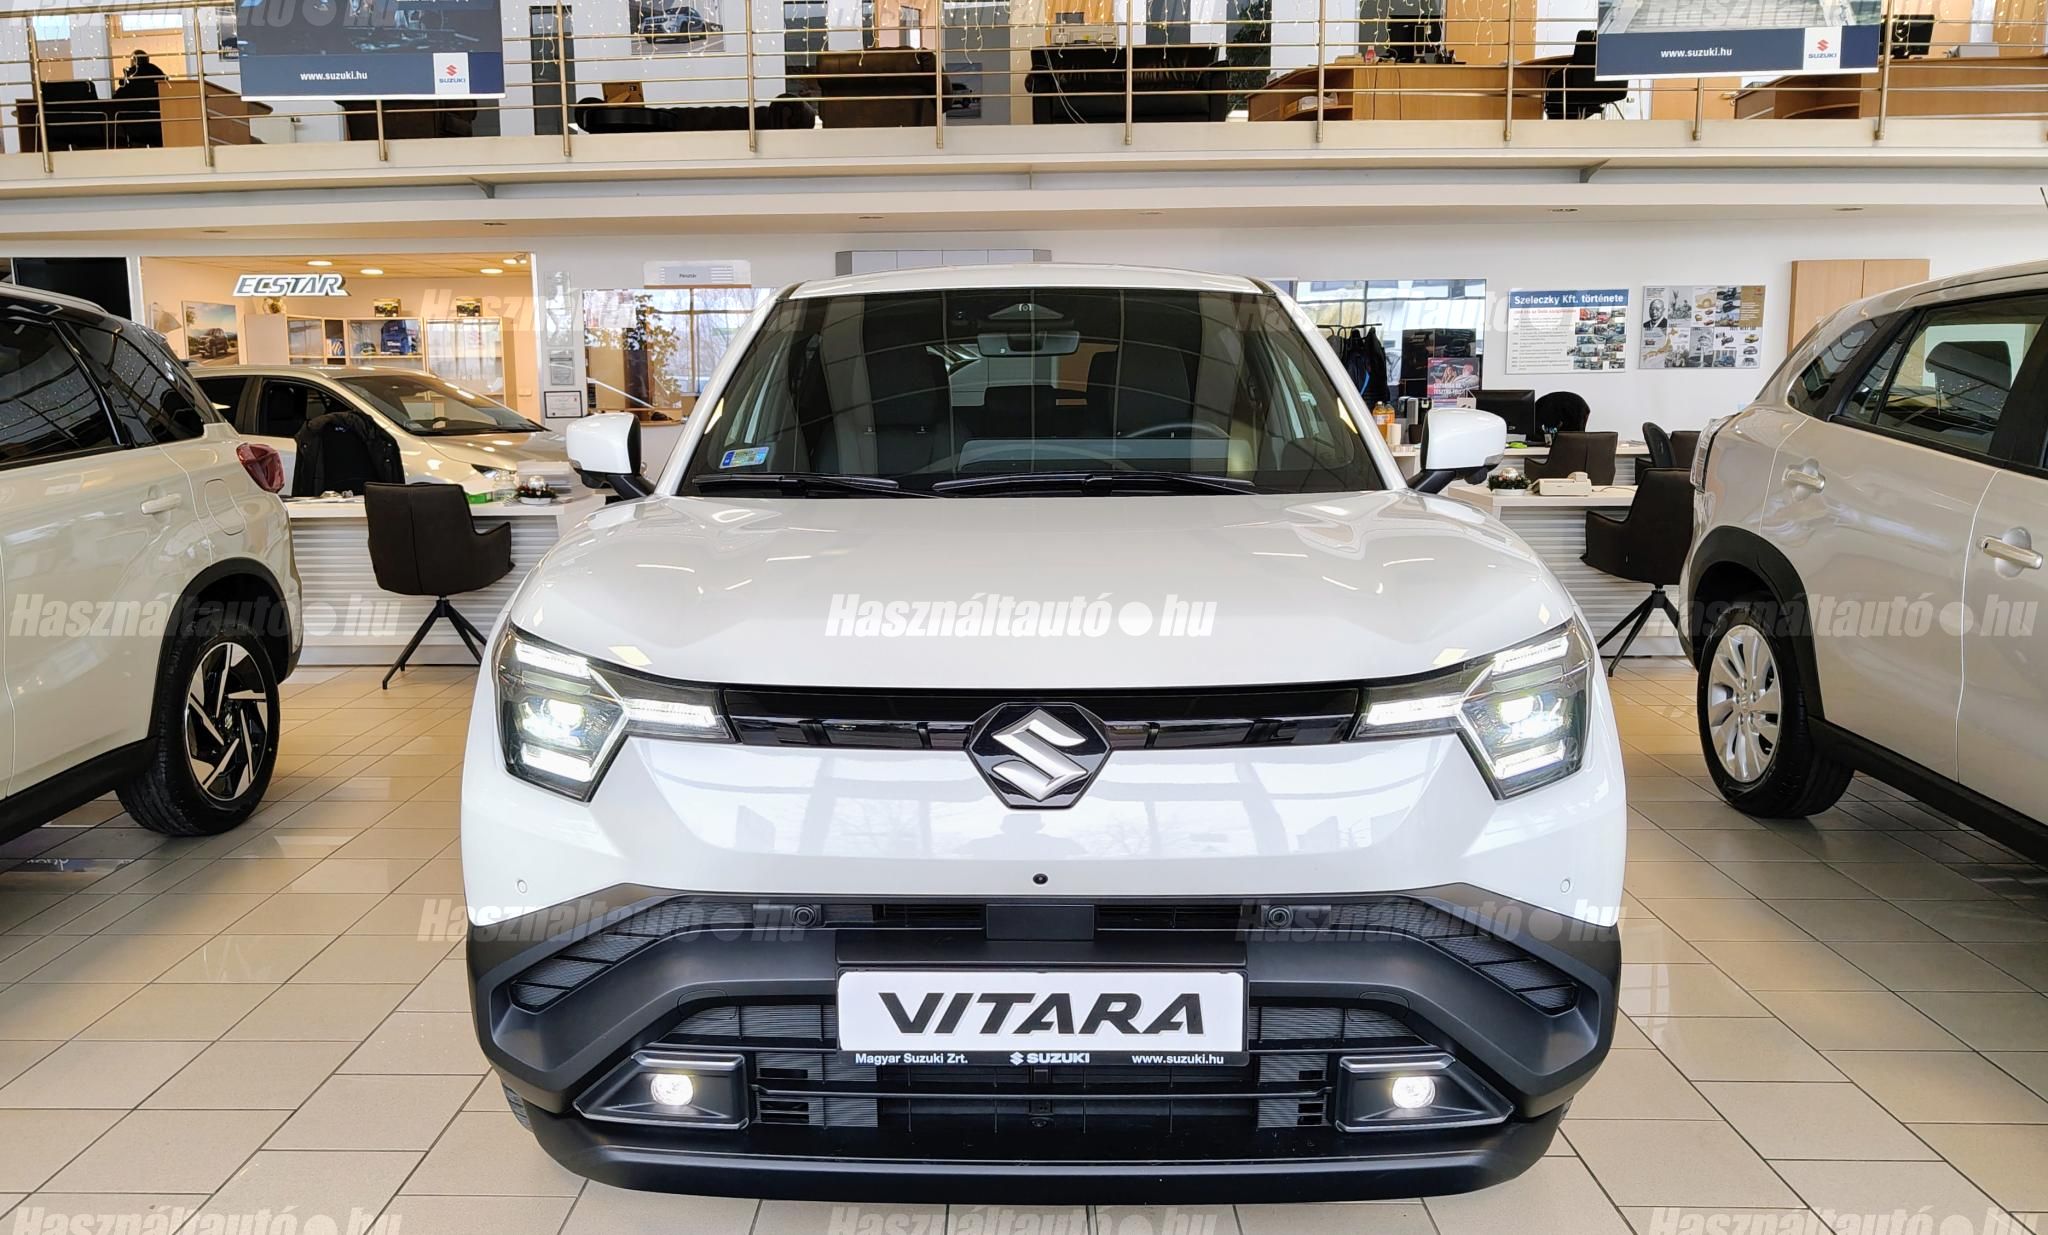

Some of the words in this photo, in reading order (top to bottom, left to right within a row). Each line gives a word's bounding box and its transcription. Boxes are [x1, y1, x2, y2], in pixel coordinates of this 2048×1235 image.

[1661, 47, 1732, 58] www.suzuki.hu
[300, 71, 368, 81] www.suzuki.hu
[233, 274, 350, 296] ECSTAR
[1514, 295, 1560, 306] Szeleczky
[1563, 294, 1579, 305] Kft.
[1582, 293, 1624, 304] története
[878, 992, 1205, 1035] VITARA
[855, 1053, 900, 1065] Magyar
[903, 1052, 943, 1064] Suzuki
[946, 1053, 968, 1064] Zrt.
[1026, 1052, 1090, 1063] SUZUKI
[1132, 1053, 1224, 1065] www.suzuki.hu
